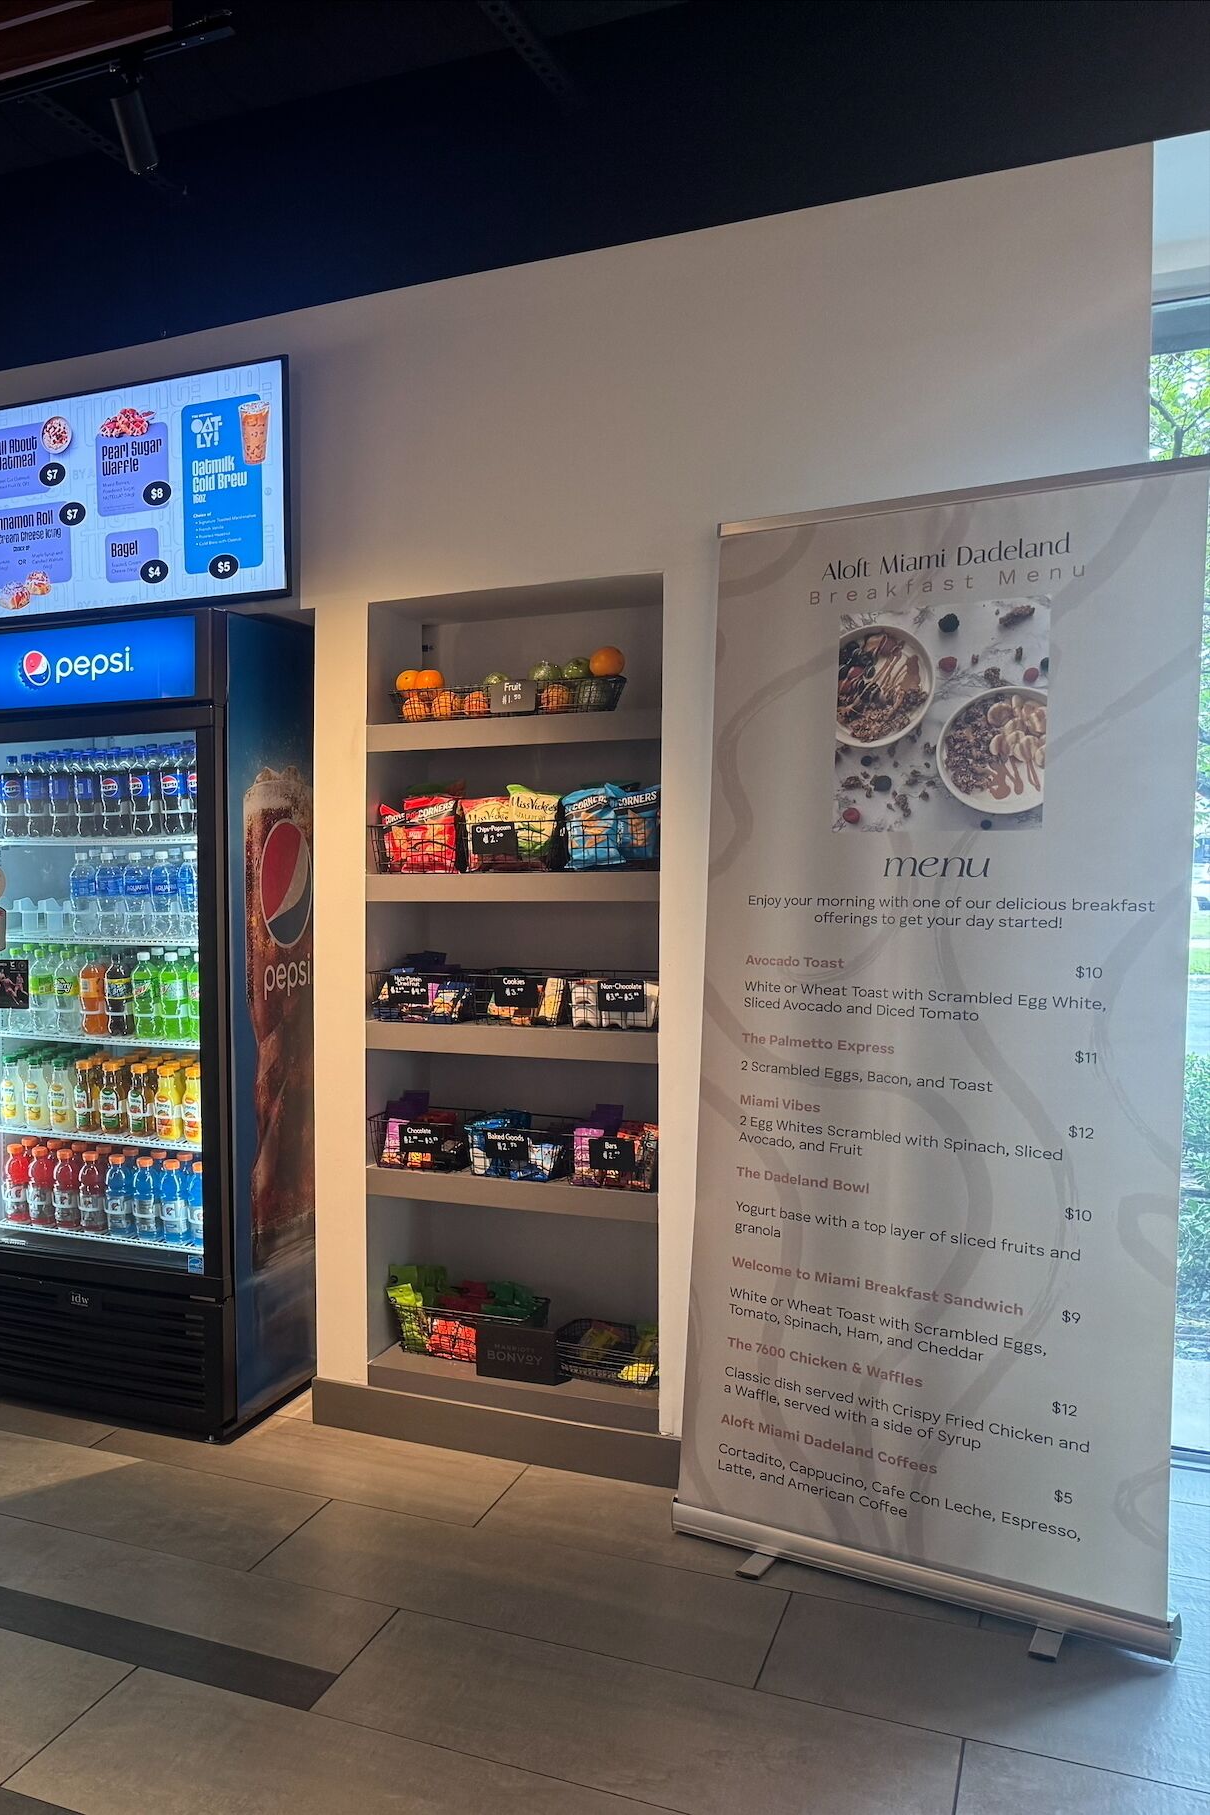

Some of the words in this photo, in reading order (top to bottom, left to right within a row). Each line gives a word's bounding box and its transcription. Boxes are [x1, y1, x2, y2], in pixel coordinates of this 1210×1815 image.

[9, 436, 38, 452] About
[101, 442, 129, 461] Pearl
[131, 438, 162, 456] Sugar
[102, 458, 139, 476] Waffle
[192, 455, 235, 477] Oatmilk
[46, 469, 58, 481] $7
[192, 474, 215, 493] Cold
[218, 471, 247, 488] Brew
[151, 488, 163, 499] $8
[36, 510, 54, 527] Roll
[66, 509, 78, 520] $7
[21, 529, 44, 541] Cheese
[45, 527, 62, 539] Icing
[111, 540, 138, 558] Bagel
[822, 557, 870, 582] Aloft
[880, 548, 946, 575] Miami
[957, 532, 1071, 566] Dadeland
[148, 566, 160, 578] $4
[218, 562, 230, 572] $5
[810, 574, 974, 605] Breakfast
[999, 563, 1086, 586] Menu
[56, 646, 131, 683] pepsi
[504, 683, 521, 691] Fruit
[883, 854, 989, 878] menu
[748, 895, 782, 907] Enjoy
[784, 896, 812, 908] your
[817, 896, 875, 910] morning
[879, 896, 908, 908] with
[913, 898, 940, 909] one
[945, 896, 962, 910] of
[966, 900, 991, 910] our
[996, 897, 1066, 911] delicious
[1072, 898, 1155, 913] breakfast
[814, 912, 877, 926] offerings
[882, 914, 895, 925] to
[899, 914, 922, 927] get
[927, 916, 959, 928] your
[966, 915, 994, 929] day
[998, 915, 1062, 929] started!
[745, 955, 799, 968] Avocado
[804, 957, 844, 969] Toast
[264, 953, 310, 1000] pepsi
[1075, 966, 1102, 980] $10
[742, 1033, 766, 1046] The
[770, 1034, 832, 1050] Palmetto
[838, 1039, 894, 1056] Express
[1075, 1051, 1097, 1065] $11
[741, 1060, 748, 1071] 2
[752, 1061, 819, 1076] Scrambled
[824, 1067, 863, 1083] Eggs,
[867, 1071, 911, 1087] Bacon,
[916, 1075, 945, 1089] and
[950, 1078, 993, 1093] Toast
[740, 1094, 779, 1110] Miami
[782, 1099, 820, 1113] Vibes
[487, 1132, 504, 1140] Baked
[505, 1133, 524, 1141] Goods
[1068, 1125, 1094, 1140] $12
[736, 1166, 760, 1180] The
[764, 1169, 828, 1189] Dadeland
[833, 1178, 870, 1194] Bowl
[1065, 1207, 1092, 1222] $10
[732, 1256, 792, 1277] Welcome
[796, 1267, 810, 1281] to
[814, 1270, 860, 1288] Miami
[864, 1278, 939, 1302] Breakfast
[944, 1292, 1023, 1316] Sandwich
[1062, 1310, 1081, 1325] $9
[728, 1337, 752, 1352] The
[755, 1343, 786, 1359] 7600
[790, 1350, 847, 1372] Chicken
[852, 1362, 862, 1374] &
[867, 1365, 923, 1388] Waffles
[1052, 1401, 1077, 1417] $12
[721, 1414, 754, 1432] Aloft
[758, 1421, 799, 1442] Miami
[804, 1432, 873, 1459] Dadeland
[877, 1451, 938, 1475] Coffees
[1054, 1490, 1072, 1504] $5
